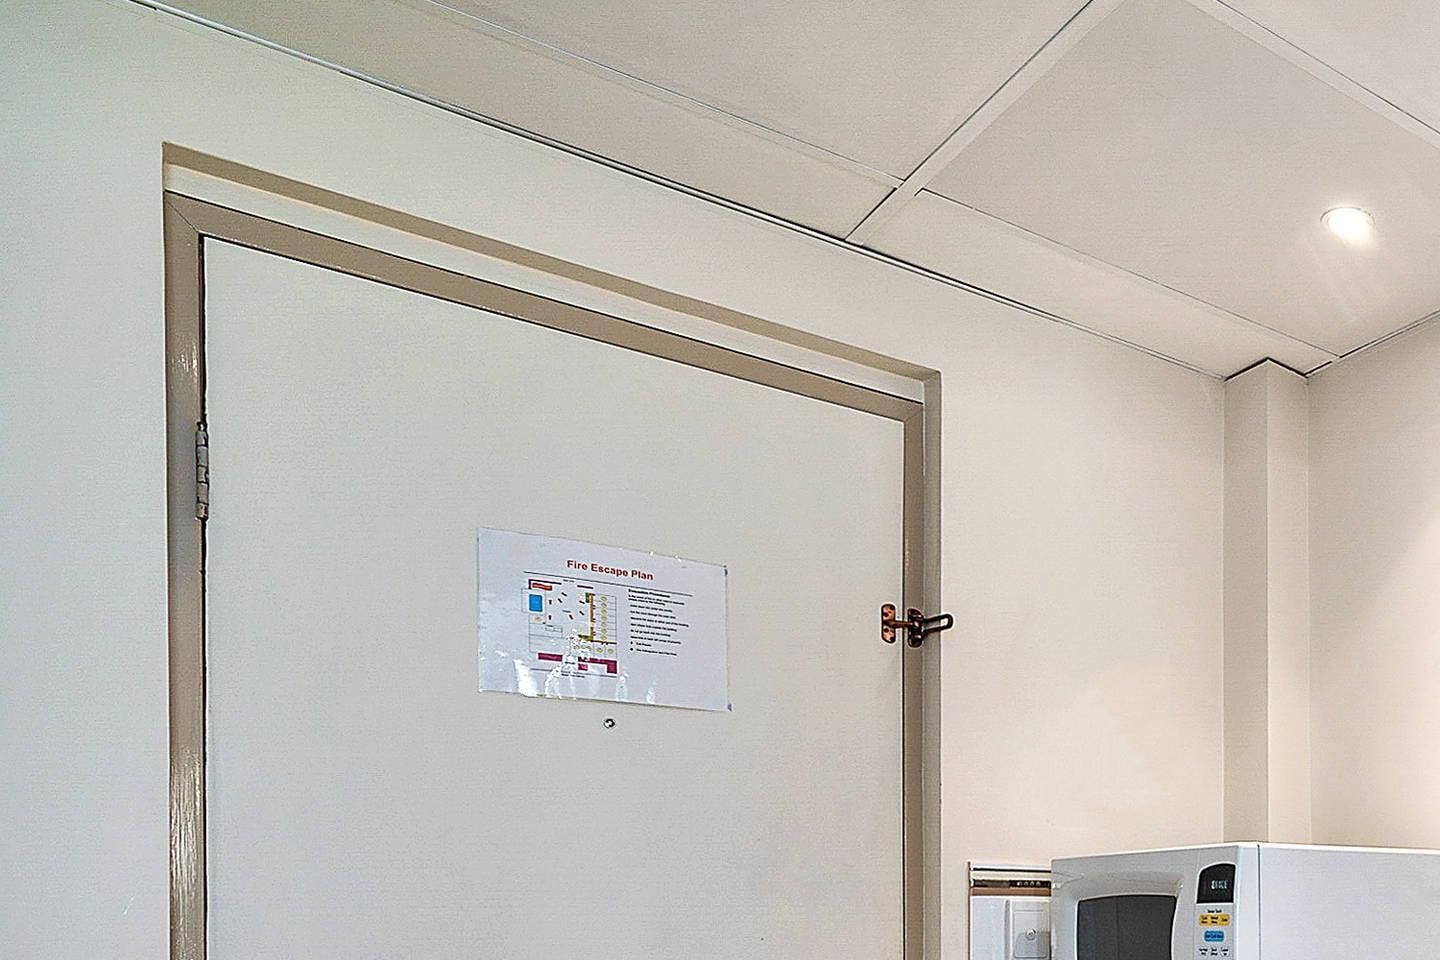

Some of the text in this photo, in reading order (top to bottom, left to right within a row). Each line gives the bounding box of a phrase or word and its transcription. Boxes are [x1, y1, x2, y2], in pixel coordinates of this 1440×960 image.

[566, 559, 654, 580] Fire Escape Plan
